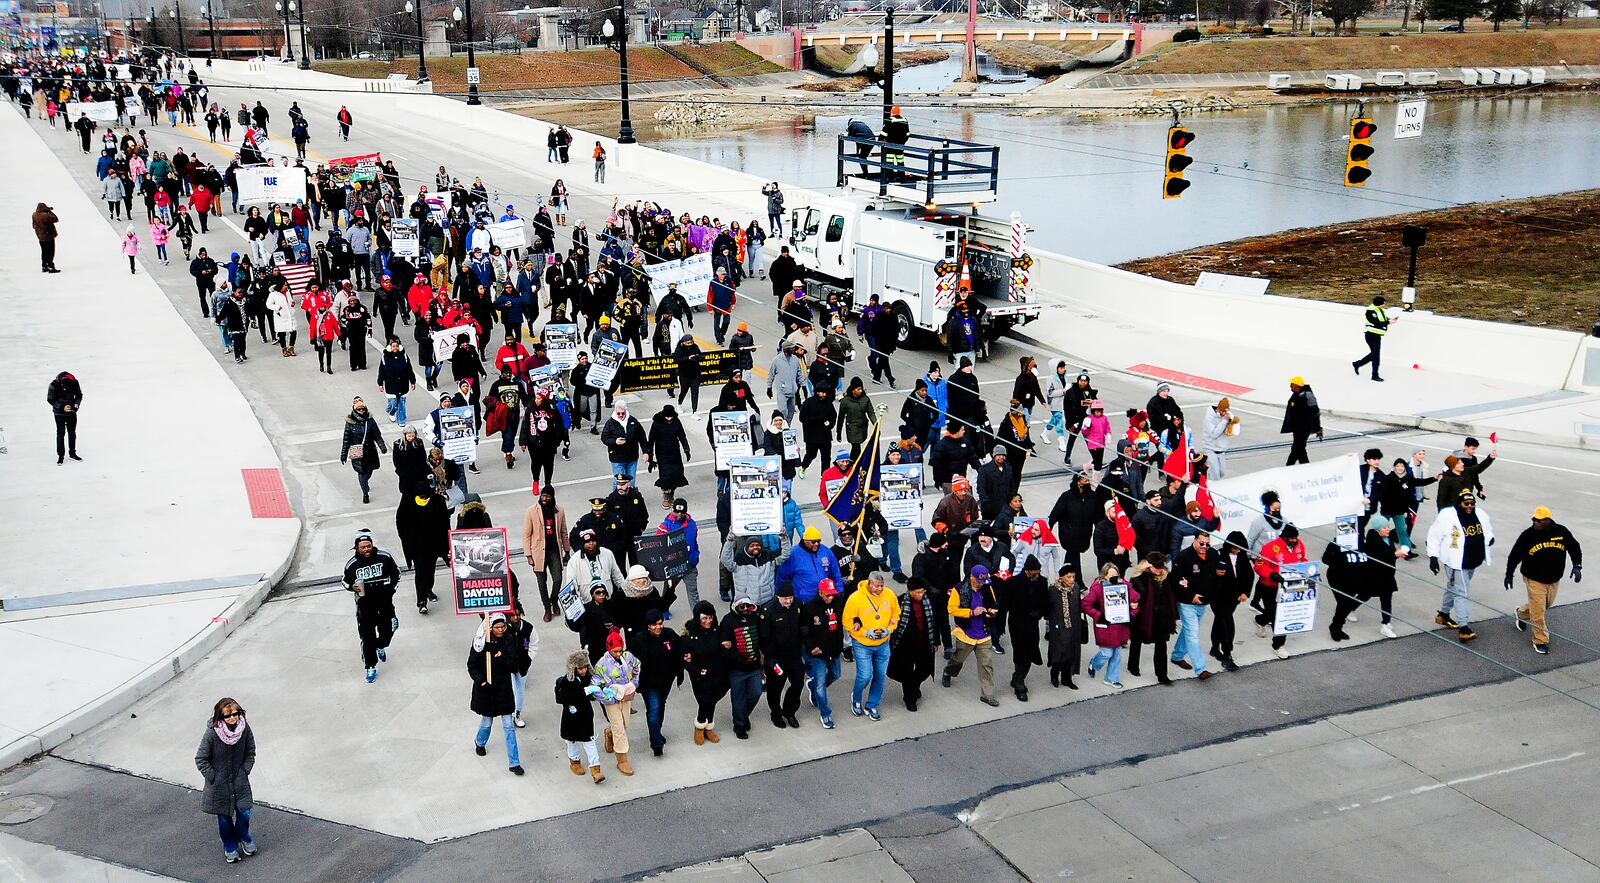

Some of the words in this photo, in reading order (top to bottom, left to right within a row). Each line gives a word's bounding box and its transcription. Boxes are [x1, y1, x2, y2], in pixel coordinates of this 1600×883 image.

[1404, 107, 1418, 118] NO
[1398, 122, 1420, 134] TURNS
[624, 360, 645, 368] Alpha
[1346, 553, 1357, 563] 19
[356, 562, 383, 579] GOAT
[462, 579, 502, 589] MAKING
[463, 588, 503, 598] DAYTON
[464, 597, 504, 606] BETTER!
